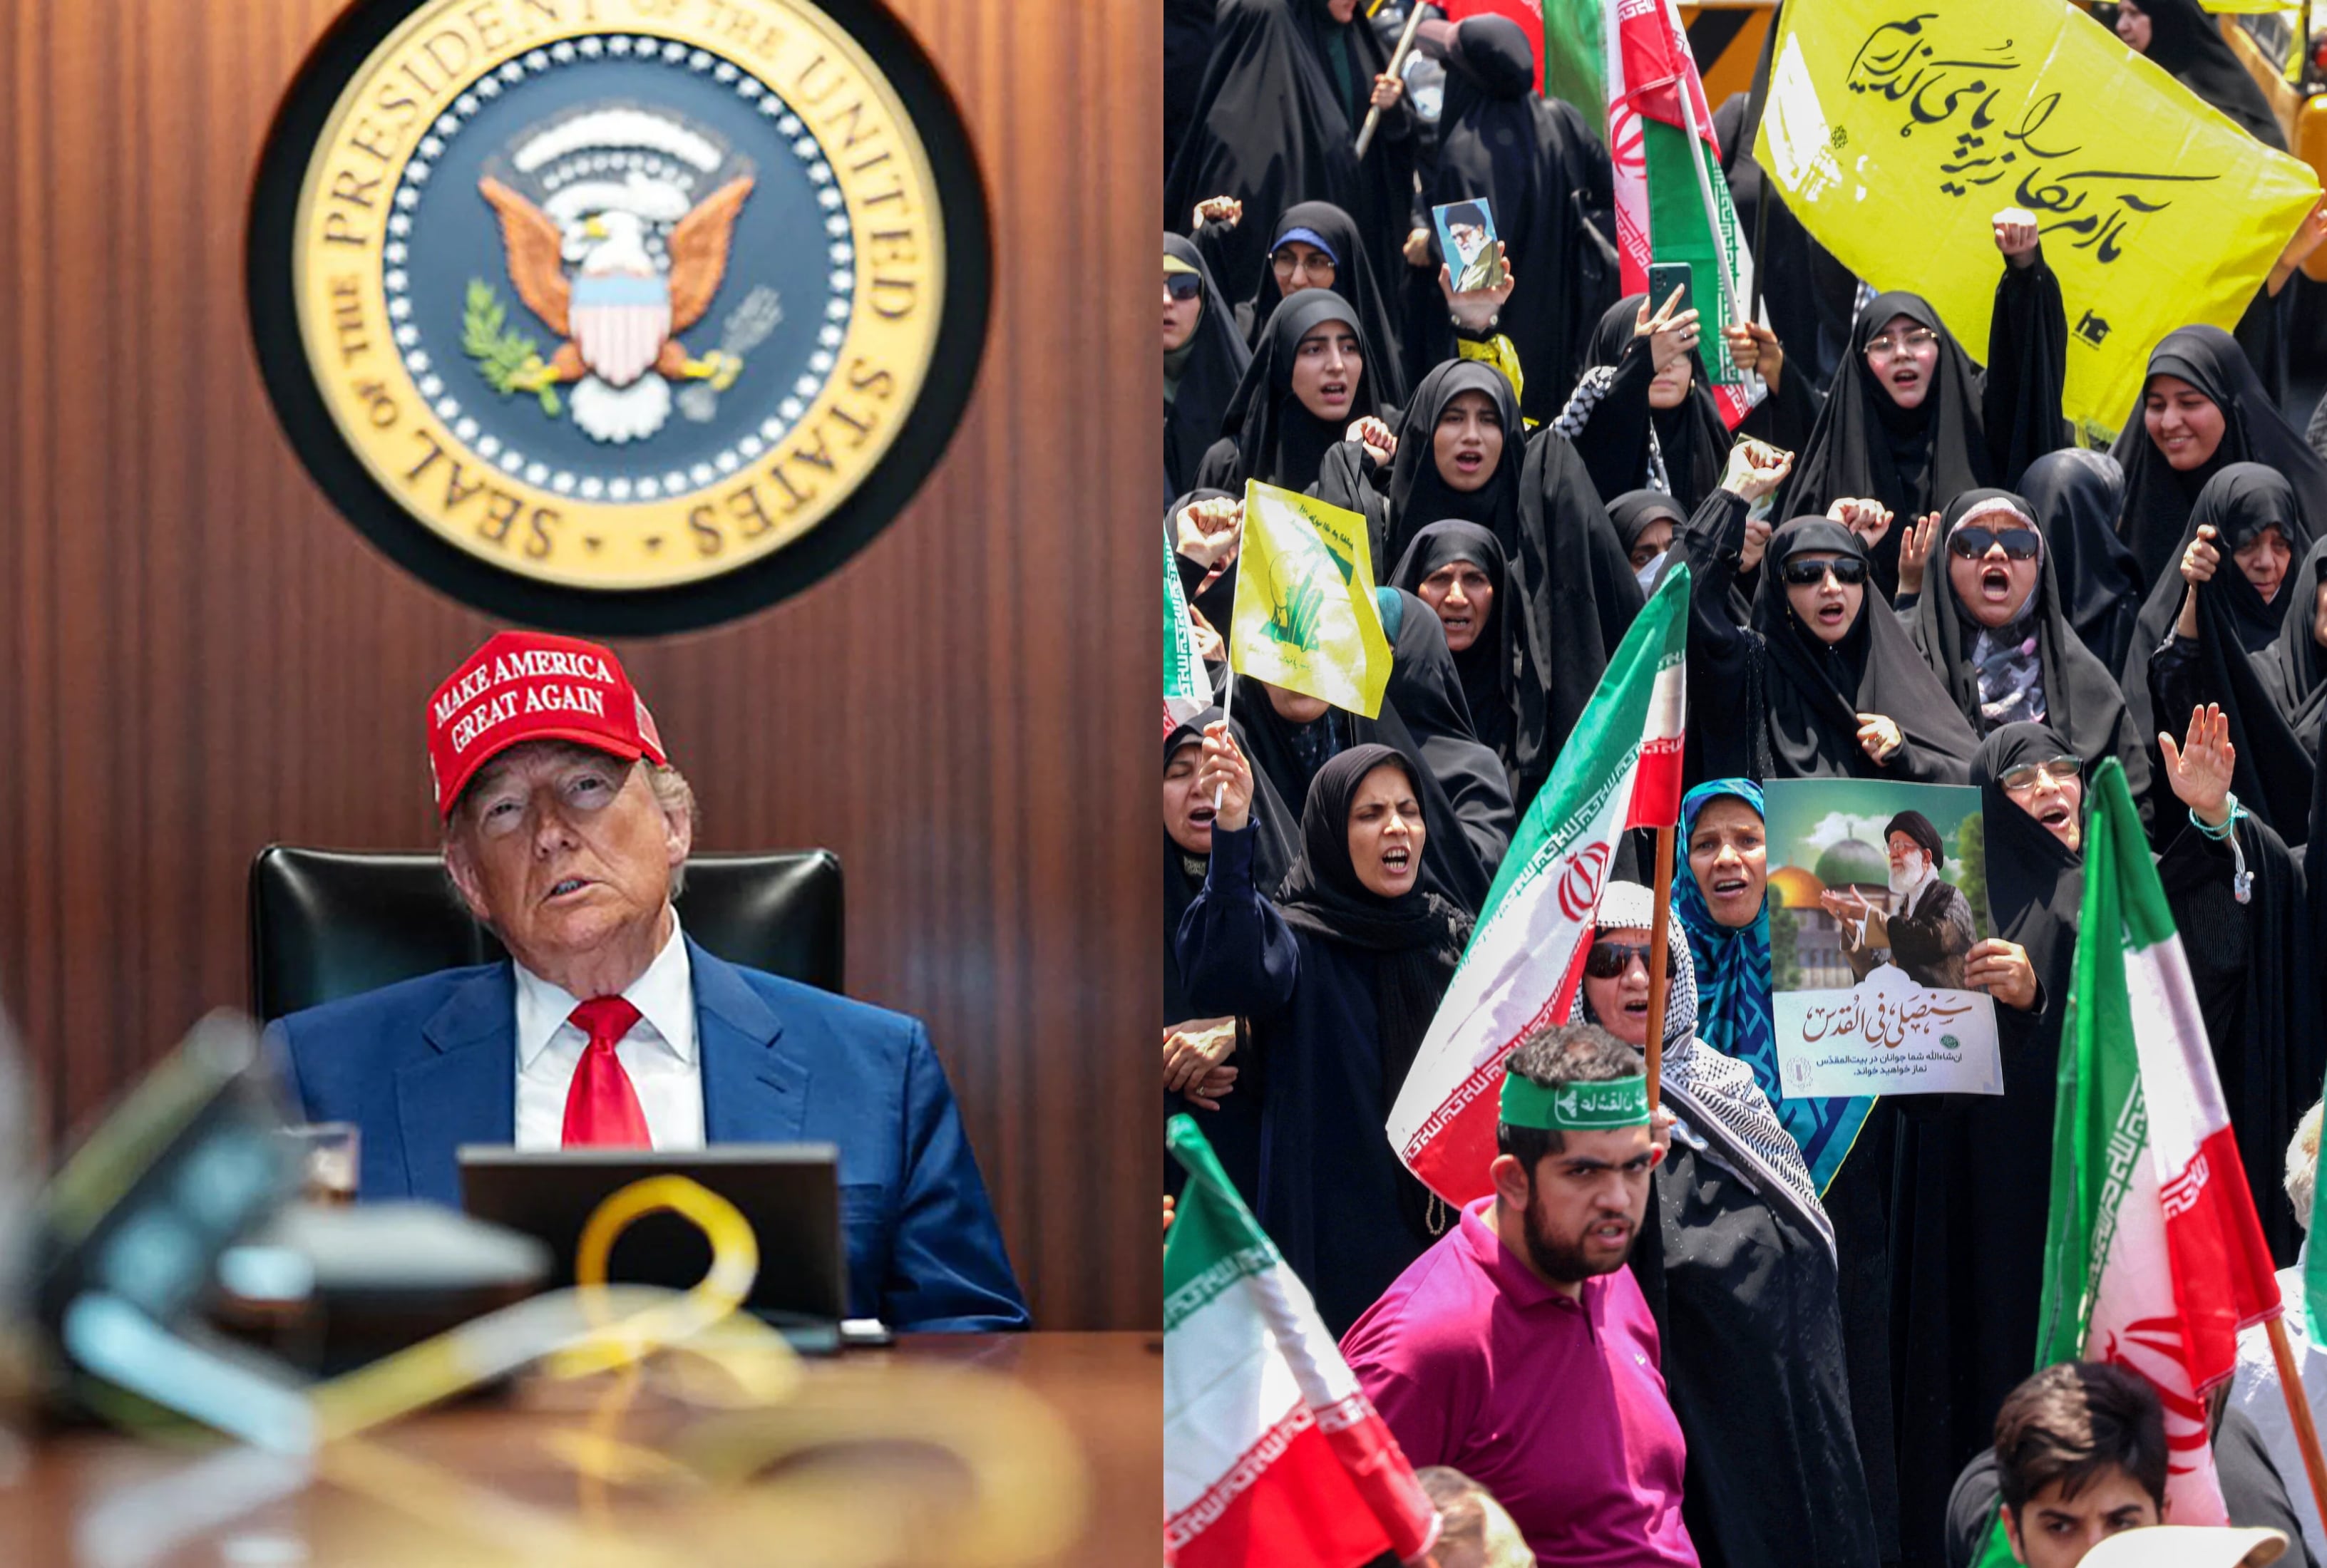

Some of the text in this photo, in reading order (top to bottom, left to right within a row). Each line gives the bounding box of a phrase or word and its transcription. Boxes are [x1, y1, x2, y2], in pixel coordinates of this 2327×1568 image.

[796, 54, 917, 319] UNITED
[332, 274, 371, 359] THE
[357, 378, 399, 429] OF
[687, 357, 895, 560] STATES
[403, 429, 564, 560] SEAL
[434, 649, 615, 730] MAKE AMERICA
[451, 684, 605, 754] GREAT AGAIN
[1869, 1056, 1878, 1065] در
[1879, 1053, 1906, 1064] جوانان
[1880, 1064, 1911, 1076] خواهید
[1908, 1052, 1924, 1061] شما
[1911, 1064, 1927, 1076] نماز
